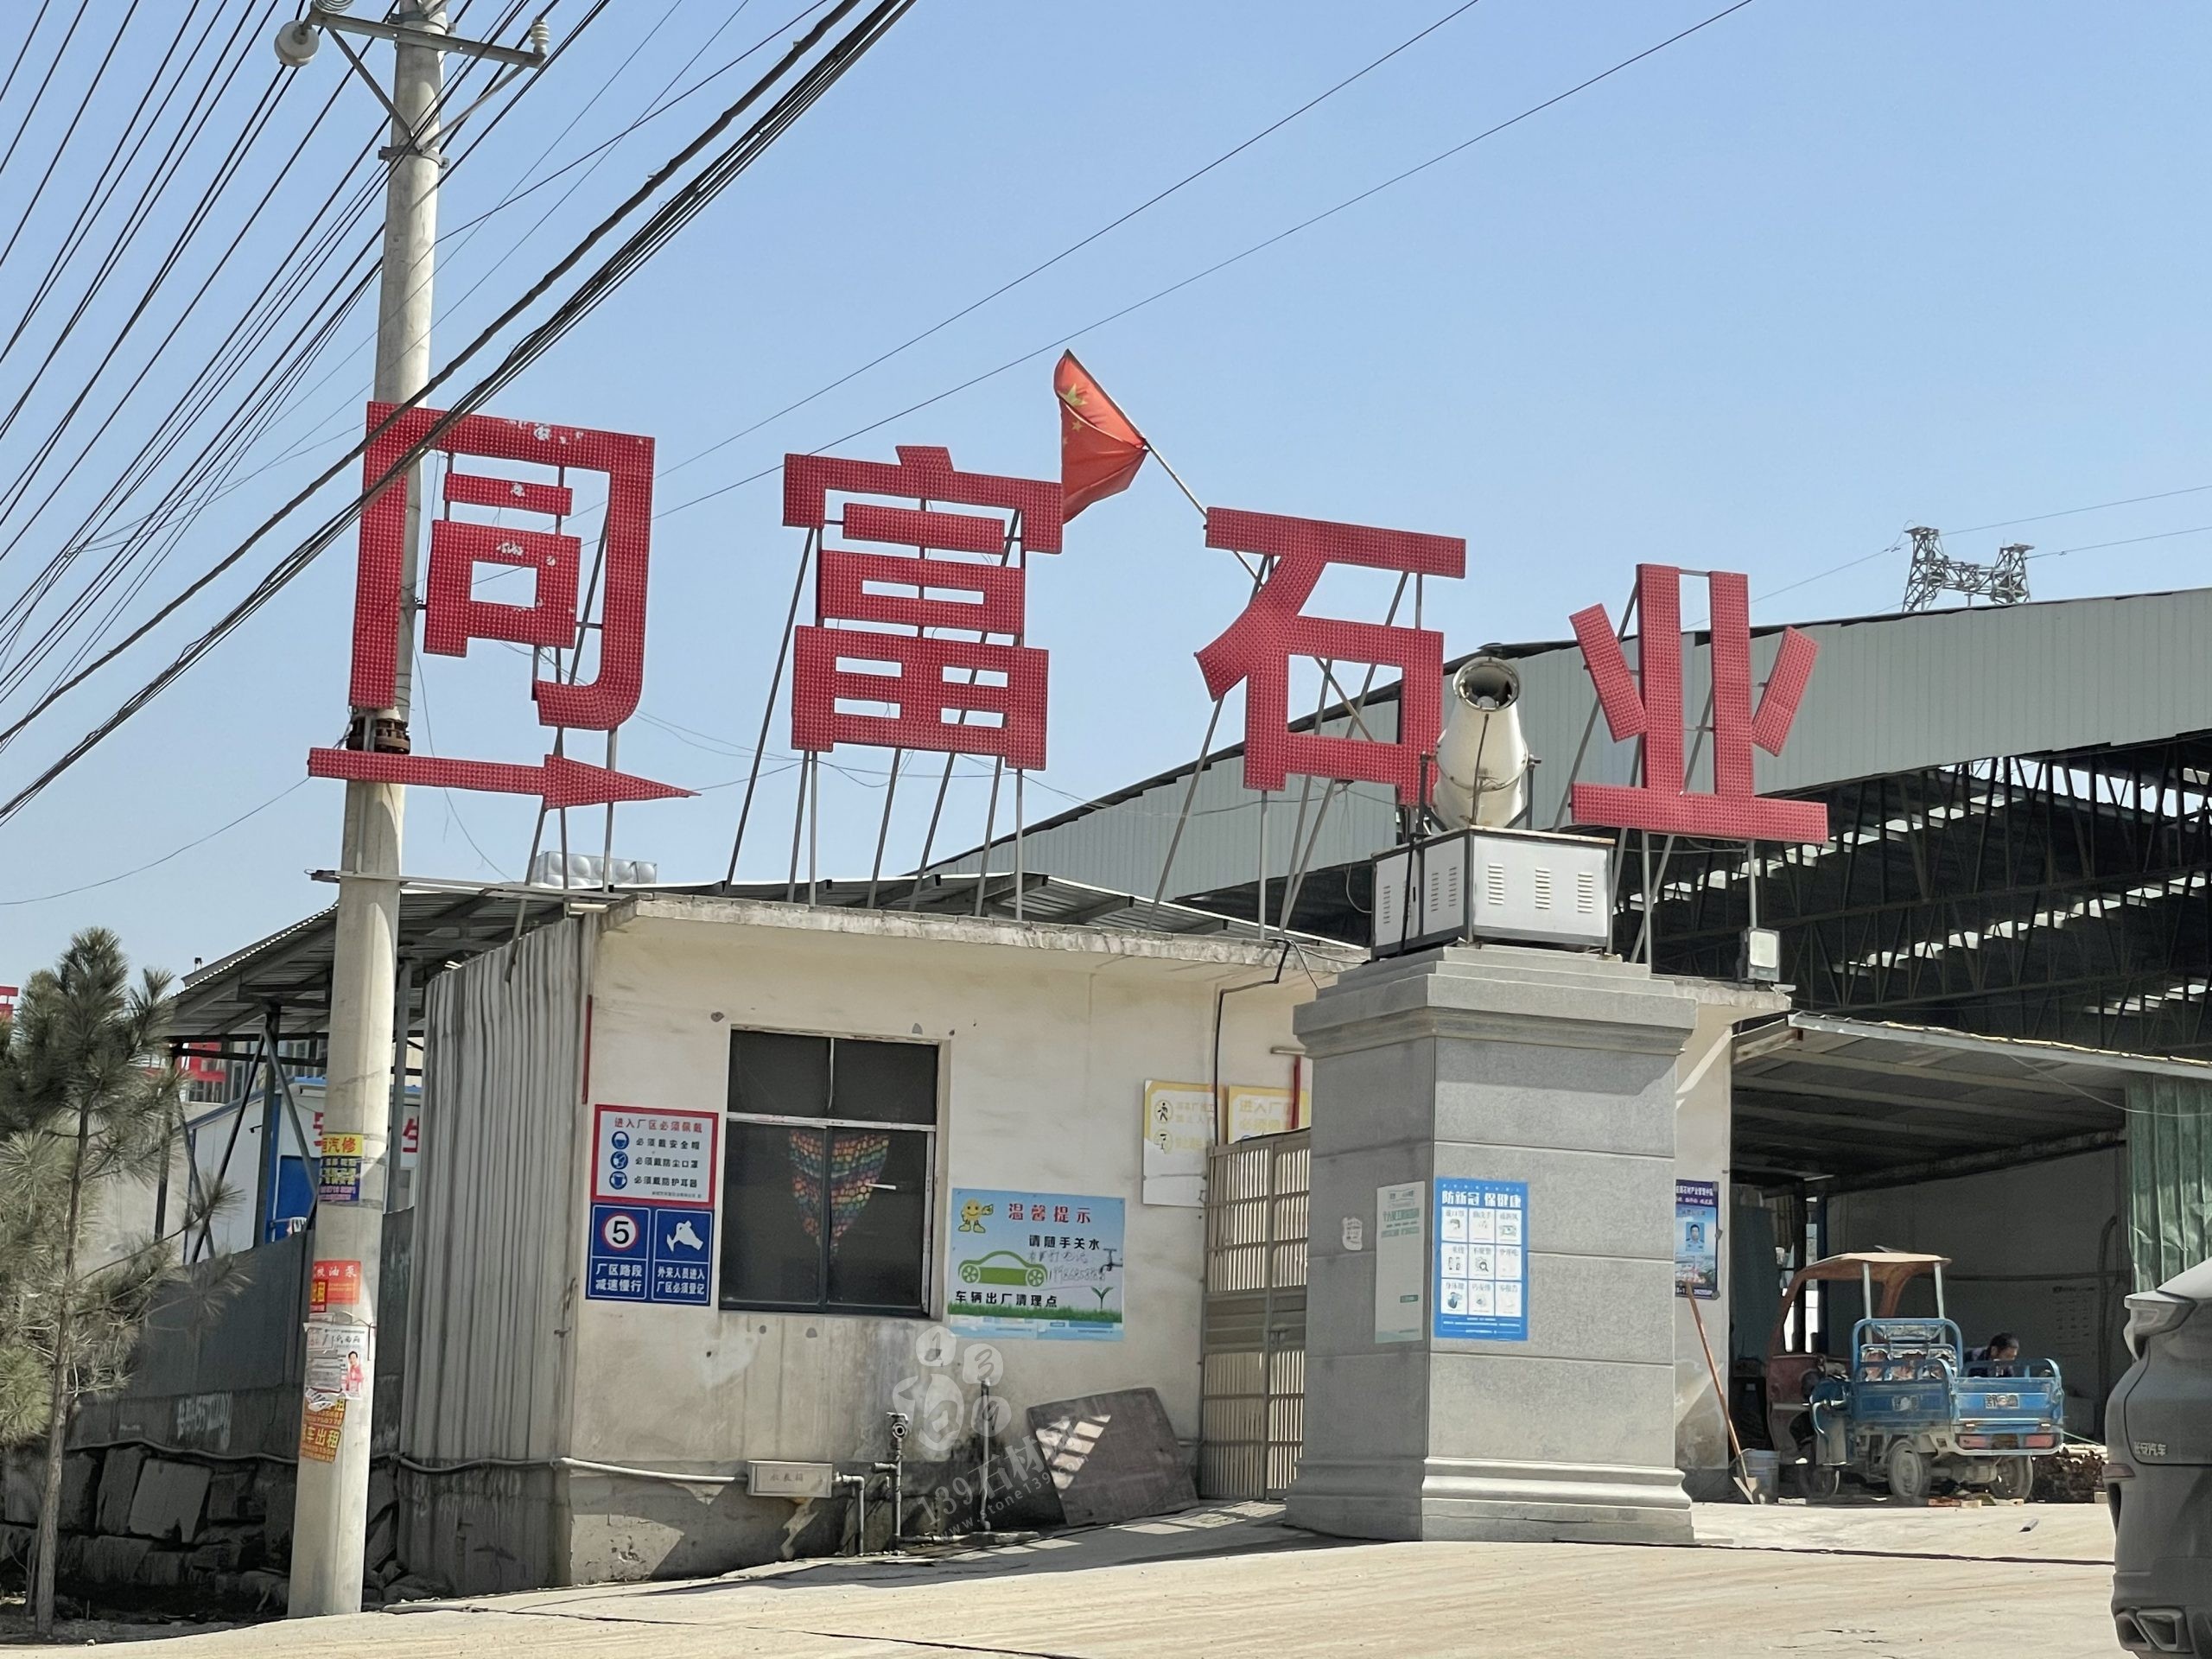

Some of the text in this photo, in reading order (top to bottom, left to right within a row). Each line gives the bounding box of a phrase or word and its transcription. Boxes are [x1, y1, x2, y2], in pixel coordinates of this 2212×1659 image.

[349, 401, 1828, 844] 同富石业
[614, 1116, 702, 1133] 进入厂区必须佩戴
[636, 1137, 700, 1150] 必须戴安全帽
[635, 1157, 698, 1168] 必须戴防尘口罩
[1008, 1203, 1091, 1224] 温馨提示
[612, 1220, 630, 1245] 5
[1029, 1234, 1100, 1251] 请随手关水
[596, 1263, 642, 1277] 厂区路段
[658, 1265, 705, 1281] 外来人员进入
[595, 1278, 642, 1293] 减速慢行
[657, 1281, 705, 1294] 厂区必须登记
[955, 1291, 1058, 1308] 车辆出厂清理点
